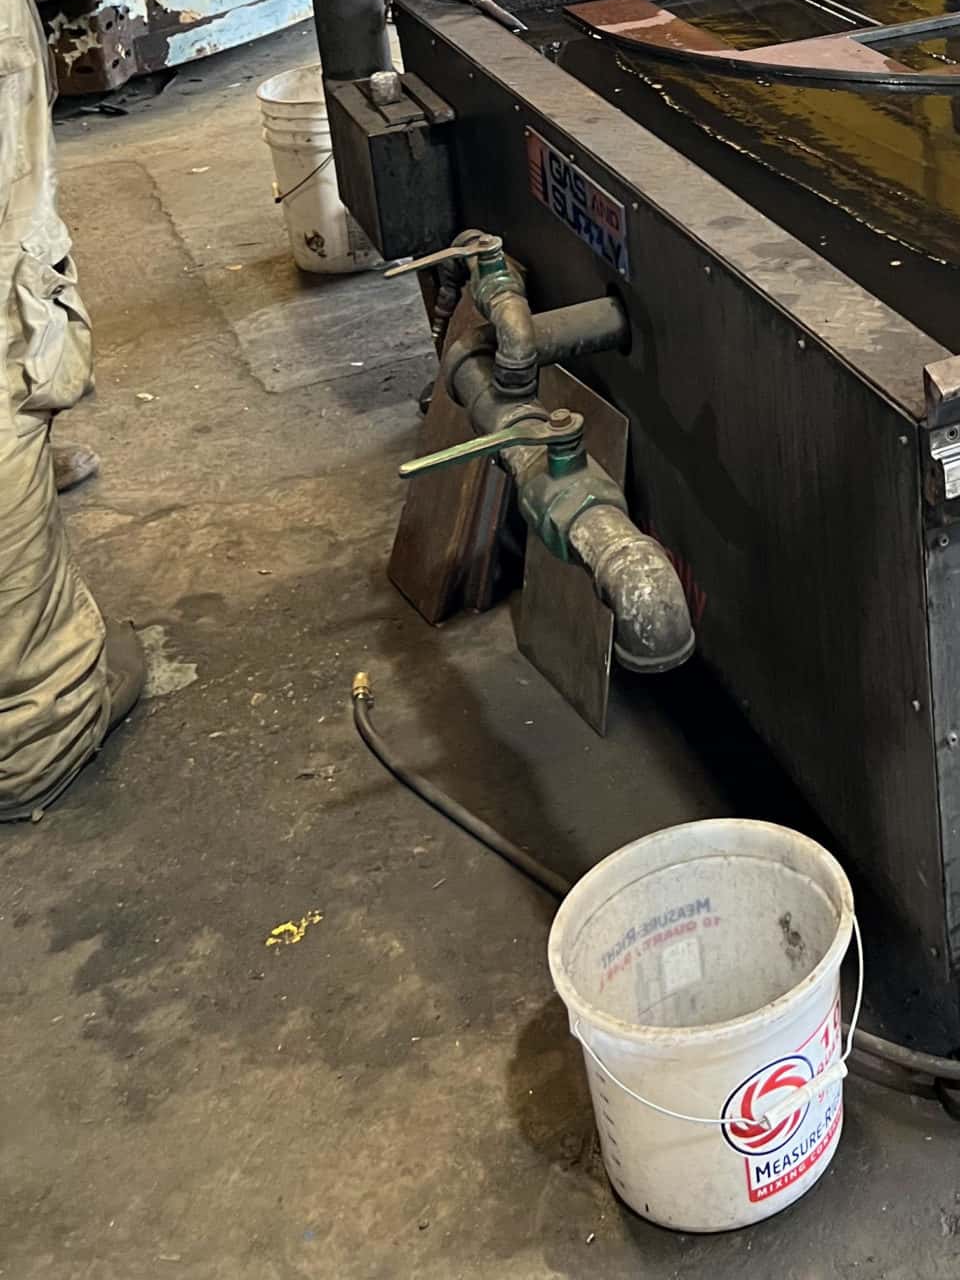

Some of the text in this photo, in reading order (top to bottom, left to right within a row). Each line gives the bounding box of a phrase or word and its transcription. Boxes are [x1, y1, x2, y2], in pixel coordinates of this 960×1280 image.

[549, 149, 620, 232] GAS AND
[755, 1087, 840, 1184] MEASURE-R
[757, 1163, 807, 1199] MIXING
